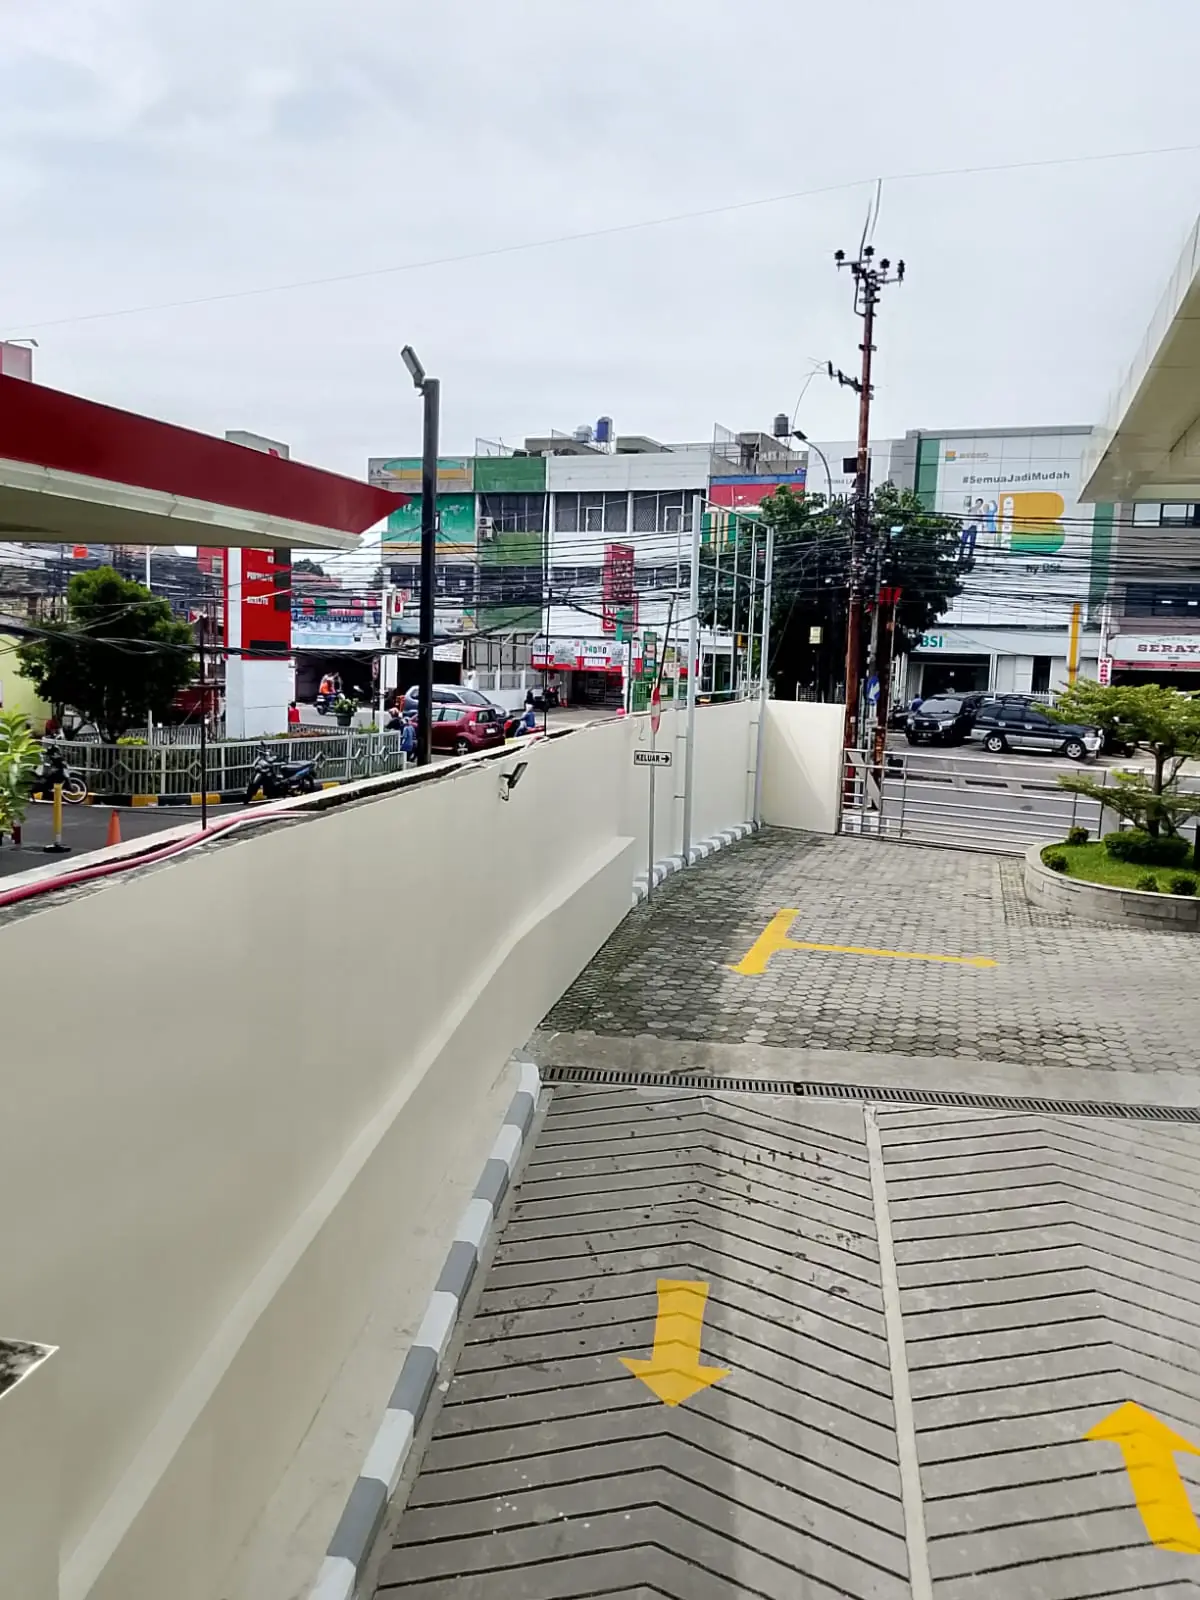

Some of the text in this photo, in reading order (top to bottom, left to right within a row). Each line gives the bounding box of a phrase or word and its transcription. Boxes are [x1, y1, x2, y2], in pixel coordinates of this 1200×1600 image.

[963, 471, 1070, 484] #SemuaJadiMudah
[920, 635, 943, 648] BSI
[1137, 644, 1200, 653] SERAY
[636, 754, 660, 763] KELUAR
